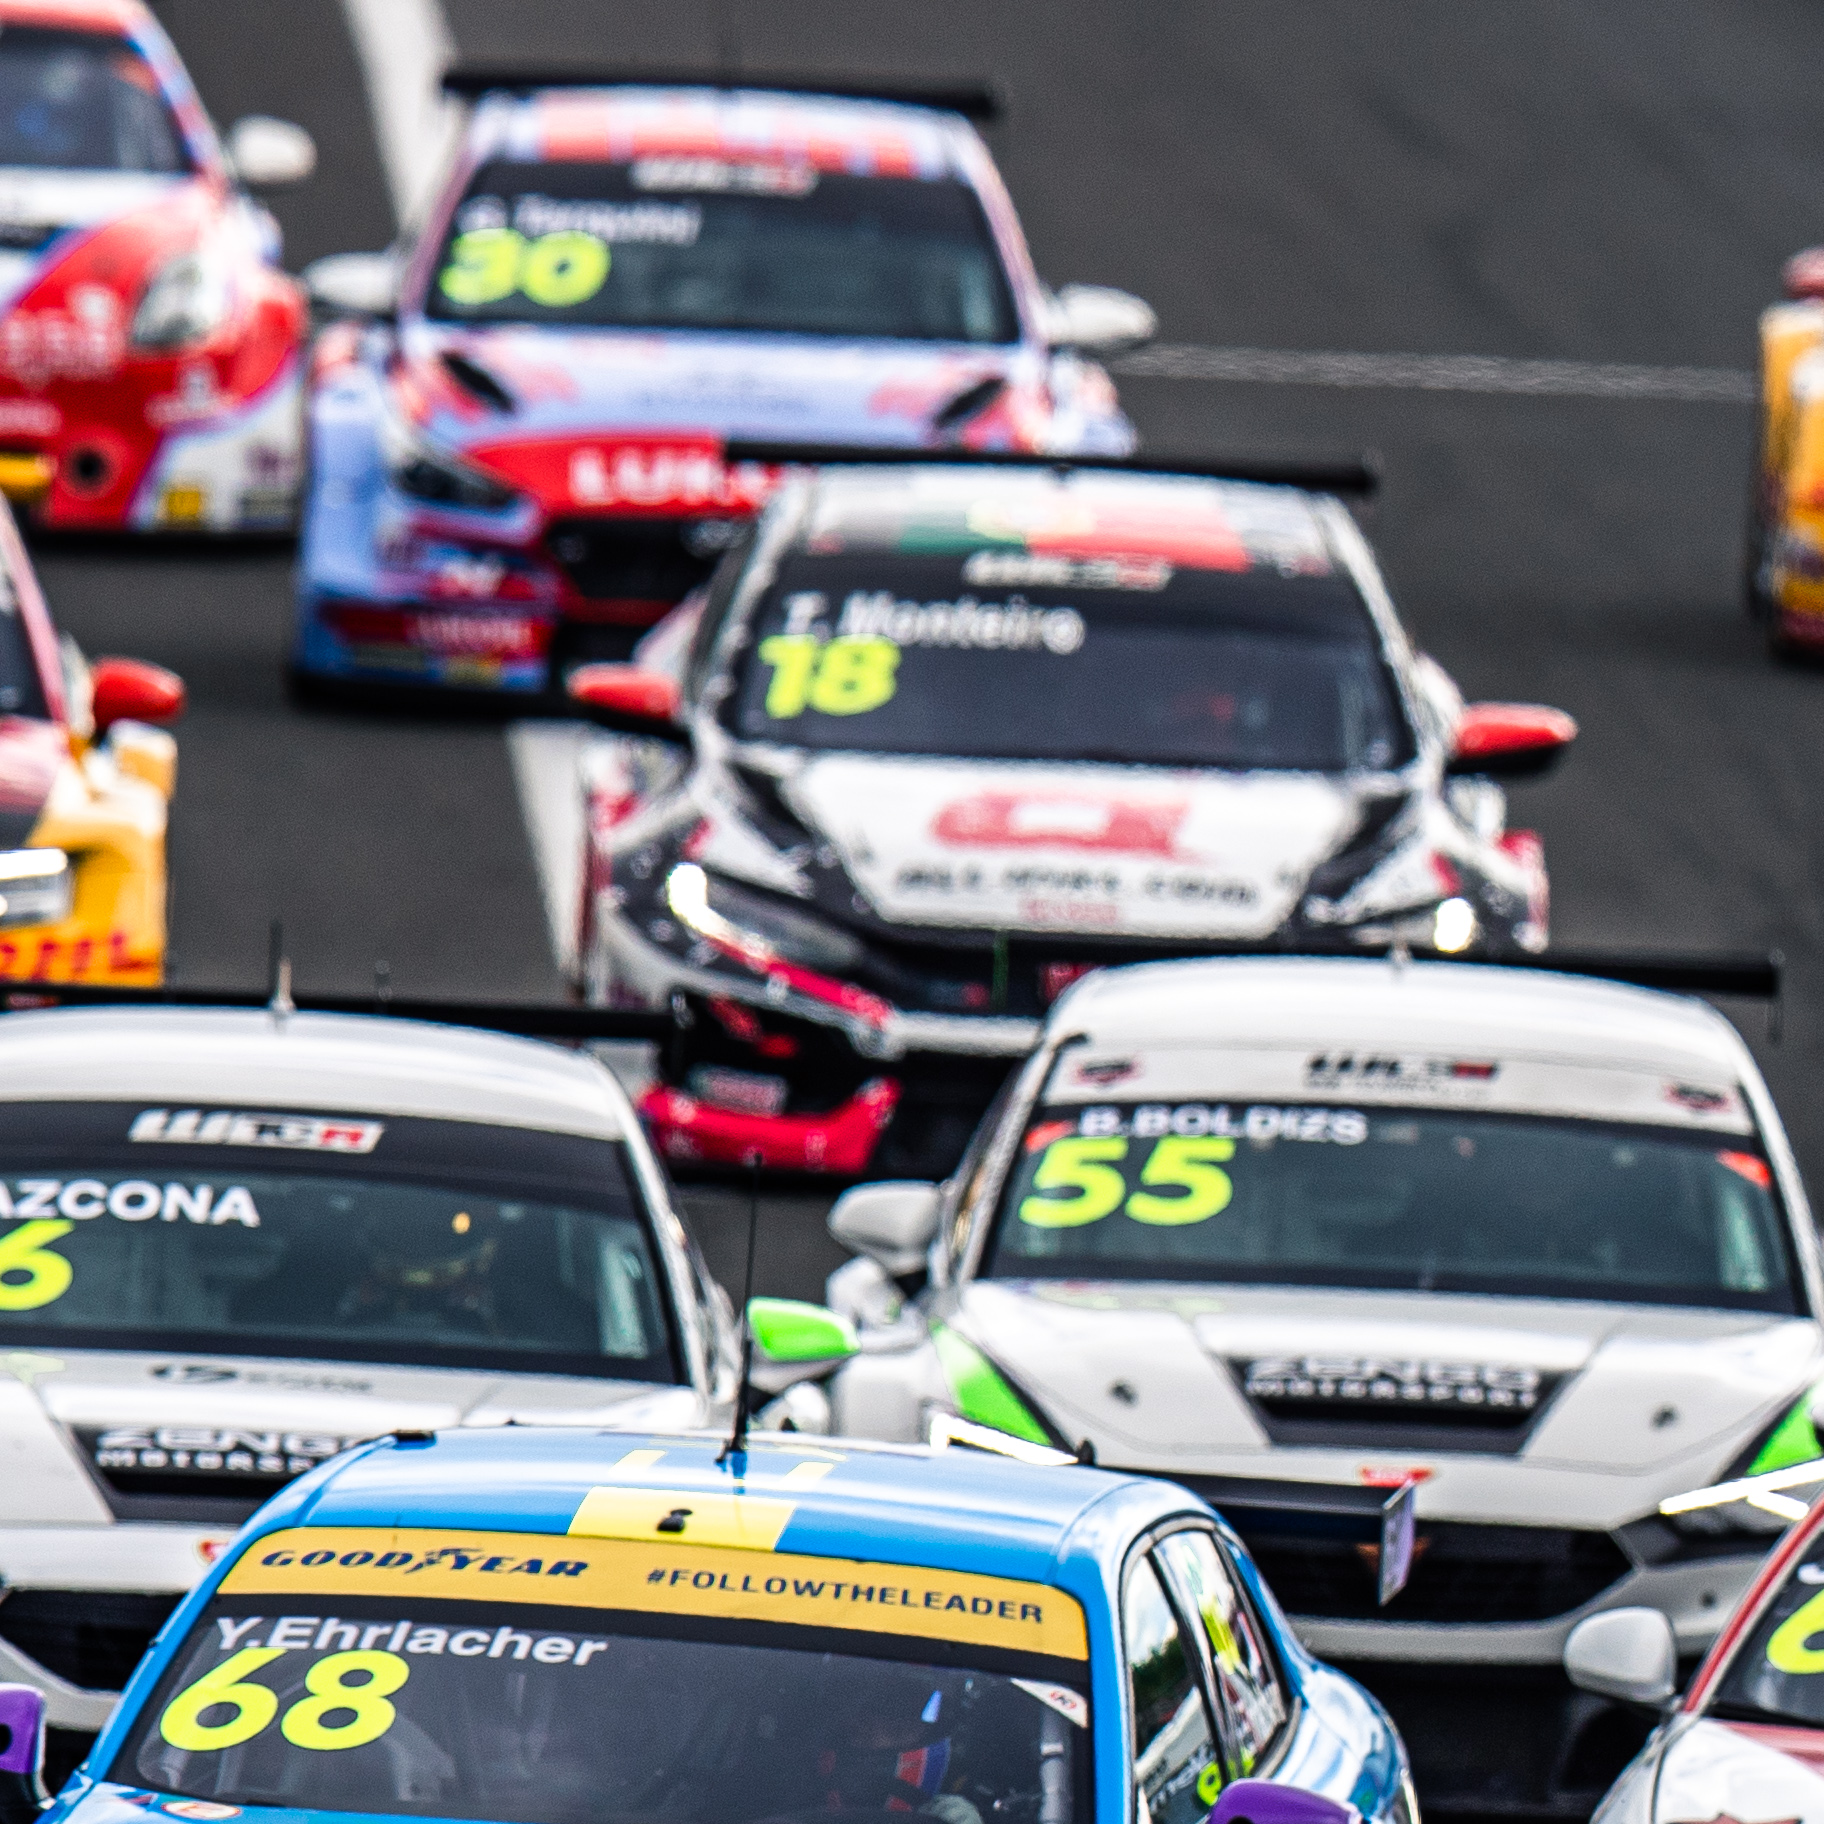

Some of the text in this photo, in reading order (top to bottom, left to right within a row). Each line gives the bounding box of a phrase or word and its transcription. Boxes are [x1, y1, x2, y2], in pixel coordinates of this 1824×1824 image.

[439, 228, 613, 308] 30
[758, 632, 902, 720] 18
[1017, 1136, 1236, 1229] 55
[96, 1427, 362, 1458] ZENG
[260, 1546, 1044, 1626] GOODYEAR #FOLLOWTHELEADER
[215, 1615, 609, 1667] Y.Ehrlacher
[159, 1645, 411, 1752] 68
